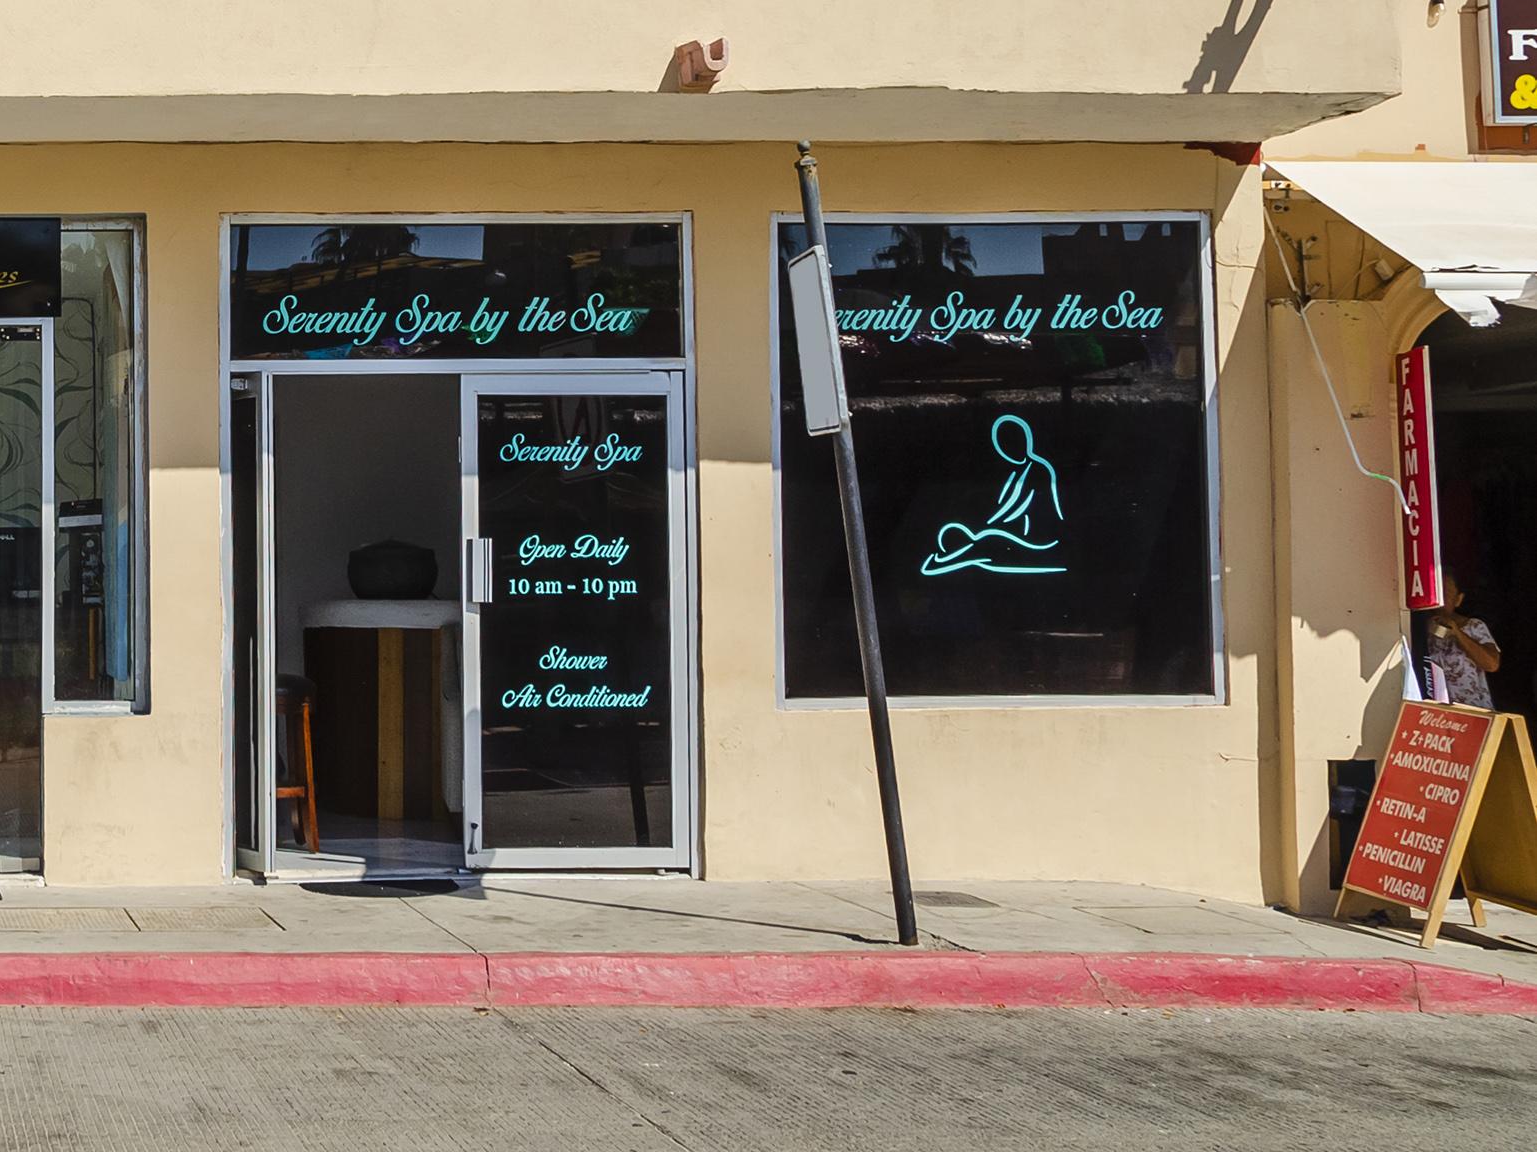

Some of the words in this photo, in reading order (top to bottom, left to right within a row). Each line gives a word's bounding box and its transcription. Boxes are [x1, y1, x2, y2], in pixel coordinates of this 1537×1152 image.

[264, 294, 387, 346] Serenity
[395, 294, 462, 345] Spa
[470, 297, 509, 345] by
[517, 297, 566, 333] the
[570, 293, 633, 333] Sea
[834, 295, 922, 343] erenity
[930, 291, 997, 342] Spa
[1003, 295, 1042, 343] by
[1050, 294, 1098, 329] the
[1102, 290, 1164, 329] Sea
[499, 433, 589, 471] Serenity
[594, 433, 643, 470] Spa
[1401, 357, 1424, 597] FARMACIA
[519, 534, 567, 566] Open
[570, 534, 630, 566] Daily
[509, 579, 530, 595] 10
[535, 582, 562, 594] am
[583, 579, 604, 594] 10
[608, 581, 637, 600] pm
[539, 646, 608, 670] Shower
[502, 684, 542, 709] Air
[546, 684, 651, 709] Conditioned
[1419, 710, 1469, 733] Welcome
[1392, 750, 1471, 782] AMOXICILINA
[1424, 783, 1460, 805] CIPRO
[1380, 797, 1428, 823] RETIN-A
[1399, 829, 1446, 855] LATISSE
[1362, 842, 1427, 874] PENICILLIN
[1382, 875, 1427, 903] VIAGRA
